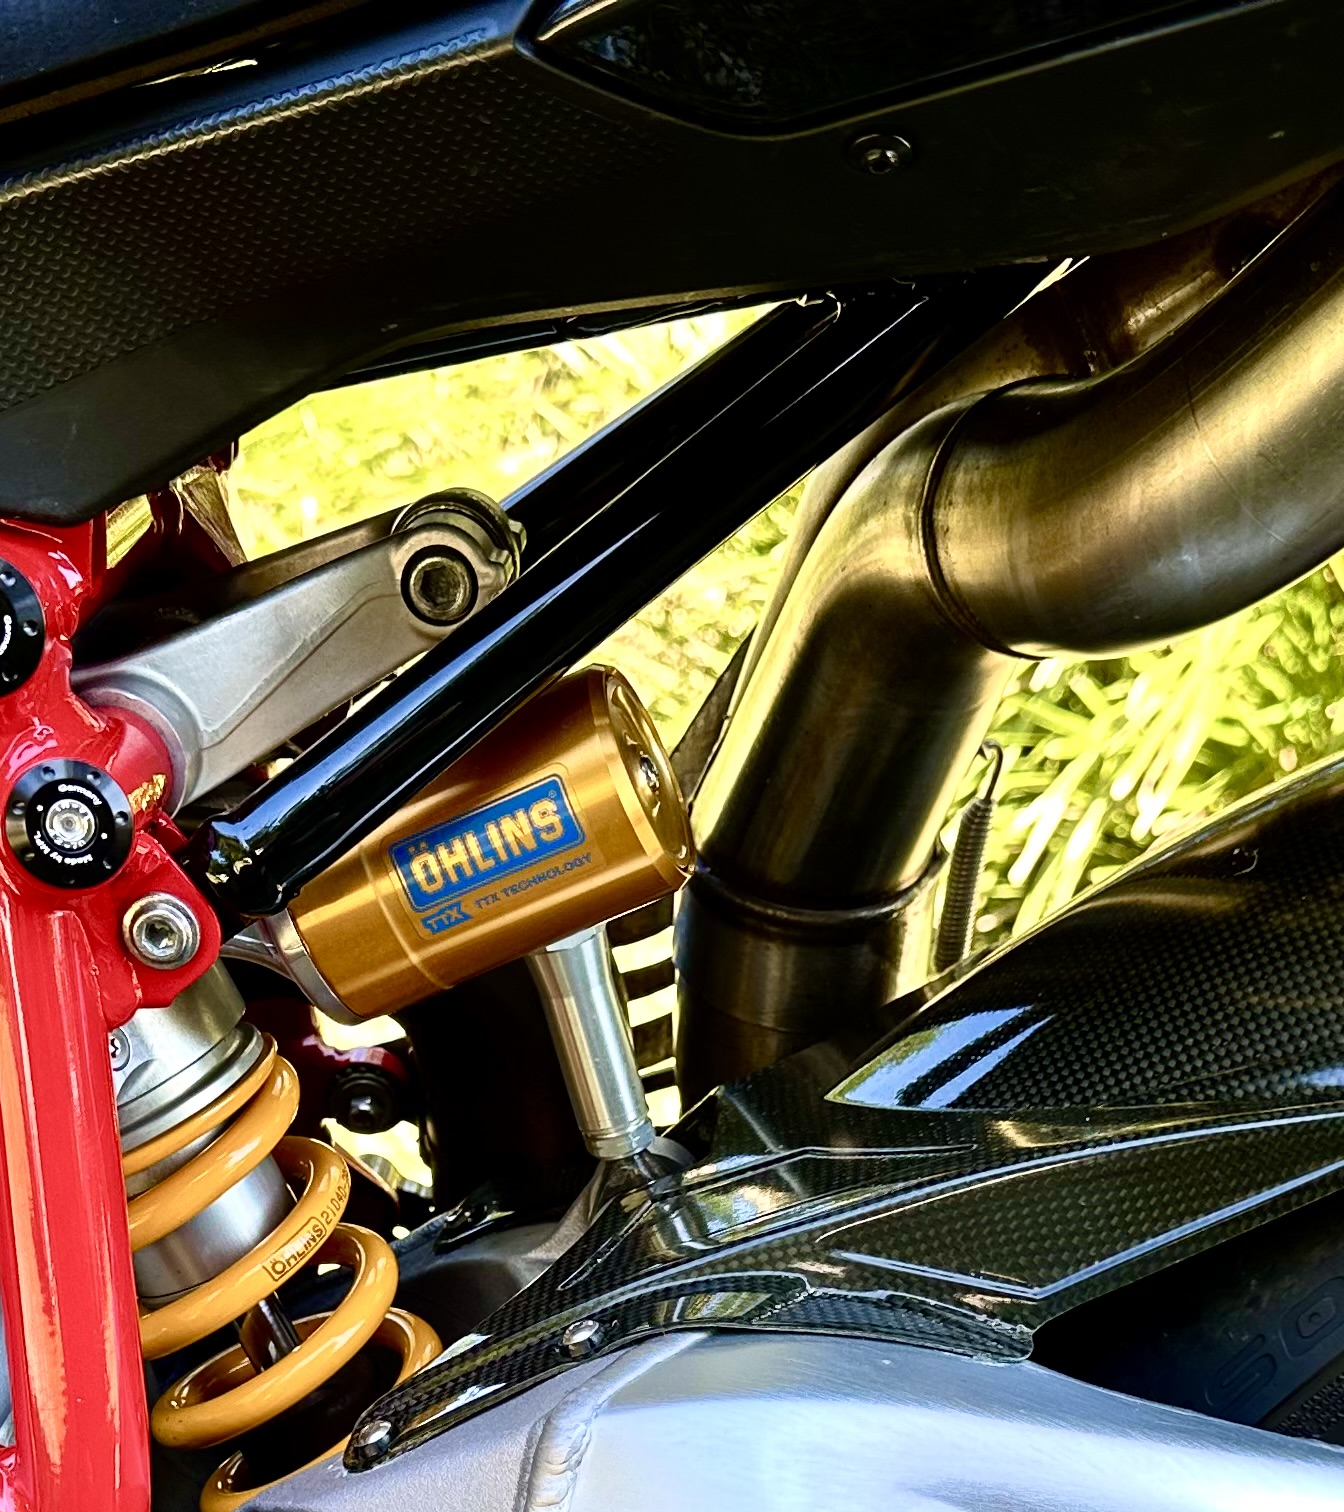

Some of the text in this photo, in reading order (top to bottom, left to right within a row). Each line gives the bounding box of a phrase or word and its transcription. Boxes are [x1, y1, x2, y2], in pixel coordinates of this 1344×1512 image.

[58, 784, 102, 805] Germany
[409, 798, 564, 894] ÖHLINS
[425, 851, 592, 931] TTX TTX TECHNOLOGY
[271, 1223, 324, 1276] ÖHLINS
